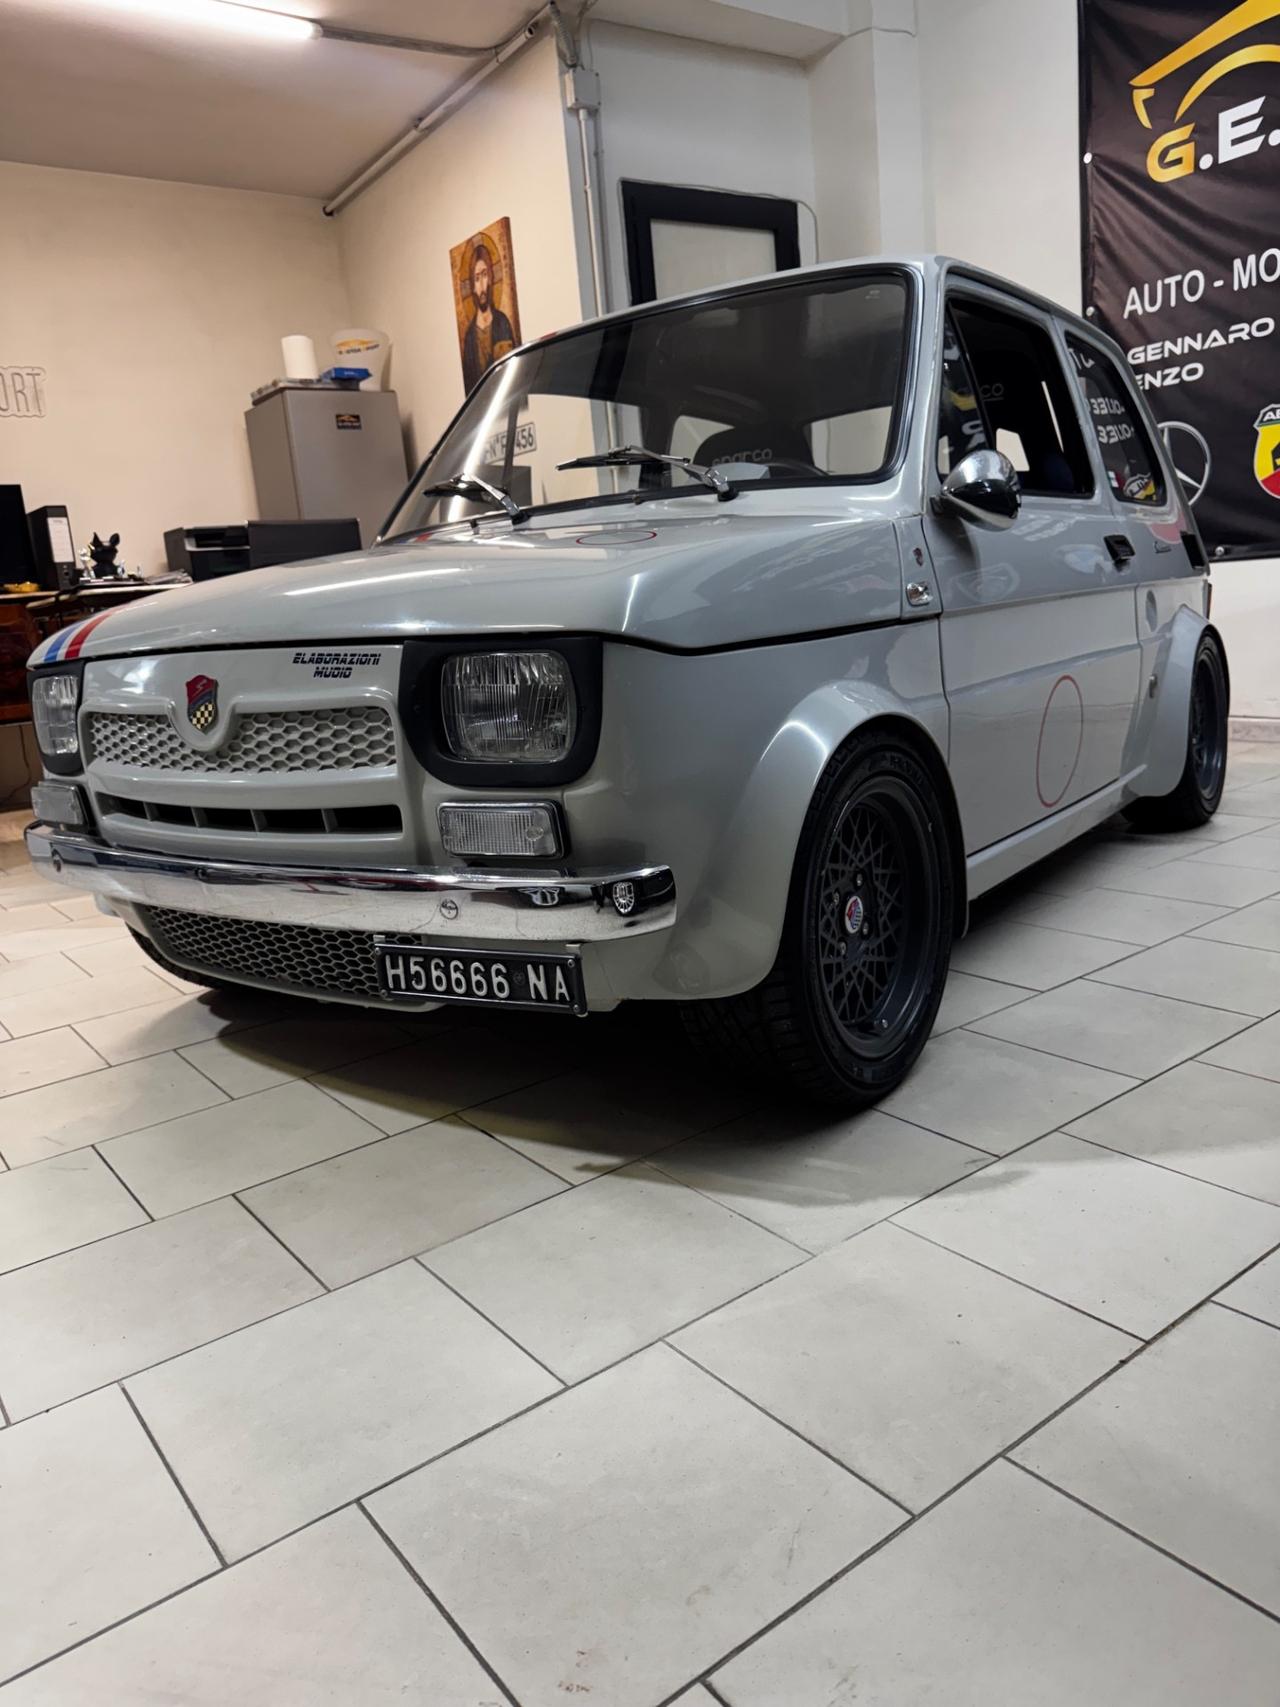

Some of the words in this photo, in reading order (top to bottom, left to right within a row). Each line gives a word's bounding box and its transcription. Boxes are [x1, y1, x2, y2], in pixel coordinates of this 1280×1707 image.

[1122, 269, 1205, 319] AUTO
[1126, 316, 1276, 365] GENNARO
[292, 652, 382, 666] ELABORAZIONI
[385, 954, 510, 999] H56666
